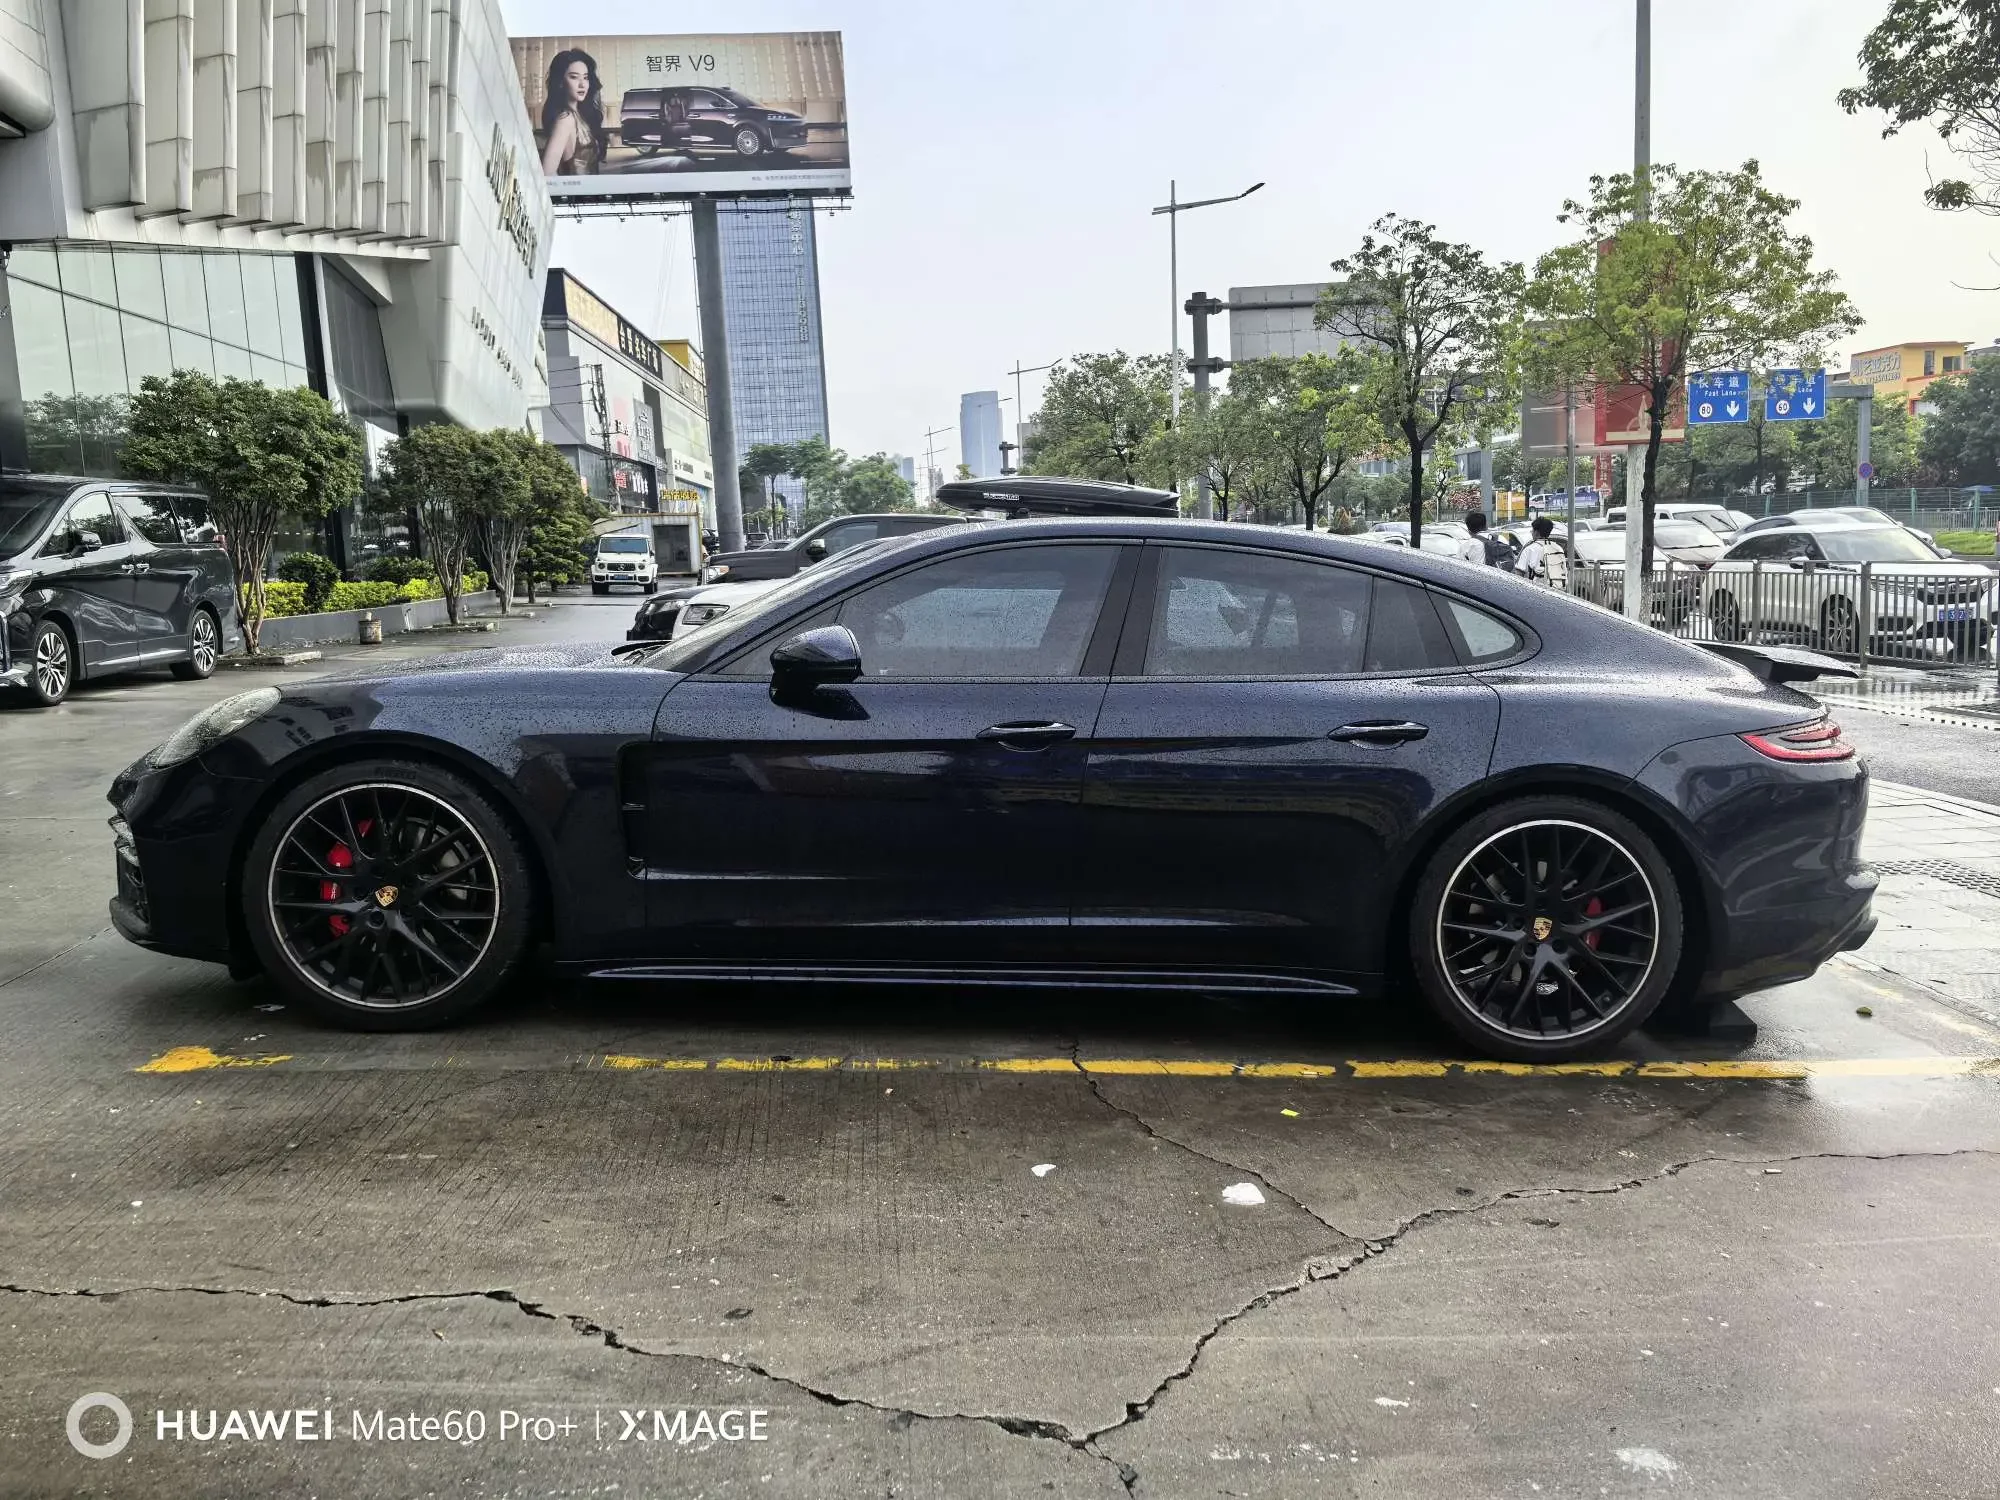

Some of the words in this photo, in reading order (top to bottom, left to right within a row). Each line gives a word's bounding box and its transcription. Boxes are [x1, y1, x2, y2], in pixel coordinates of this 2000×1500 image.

[646, 55, 681, 72] 智界
[688, 54, 715, 72] V9
[1721, 389, 1737, 397] Lane
[1701, 406, 1711, 415] 80
[1778, 402, 1788, 411] 60
